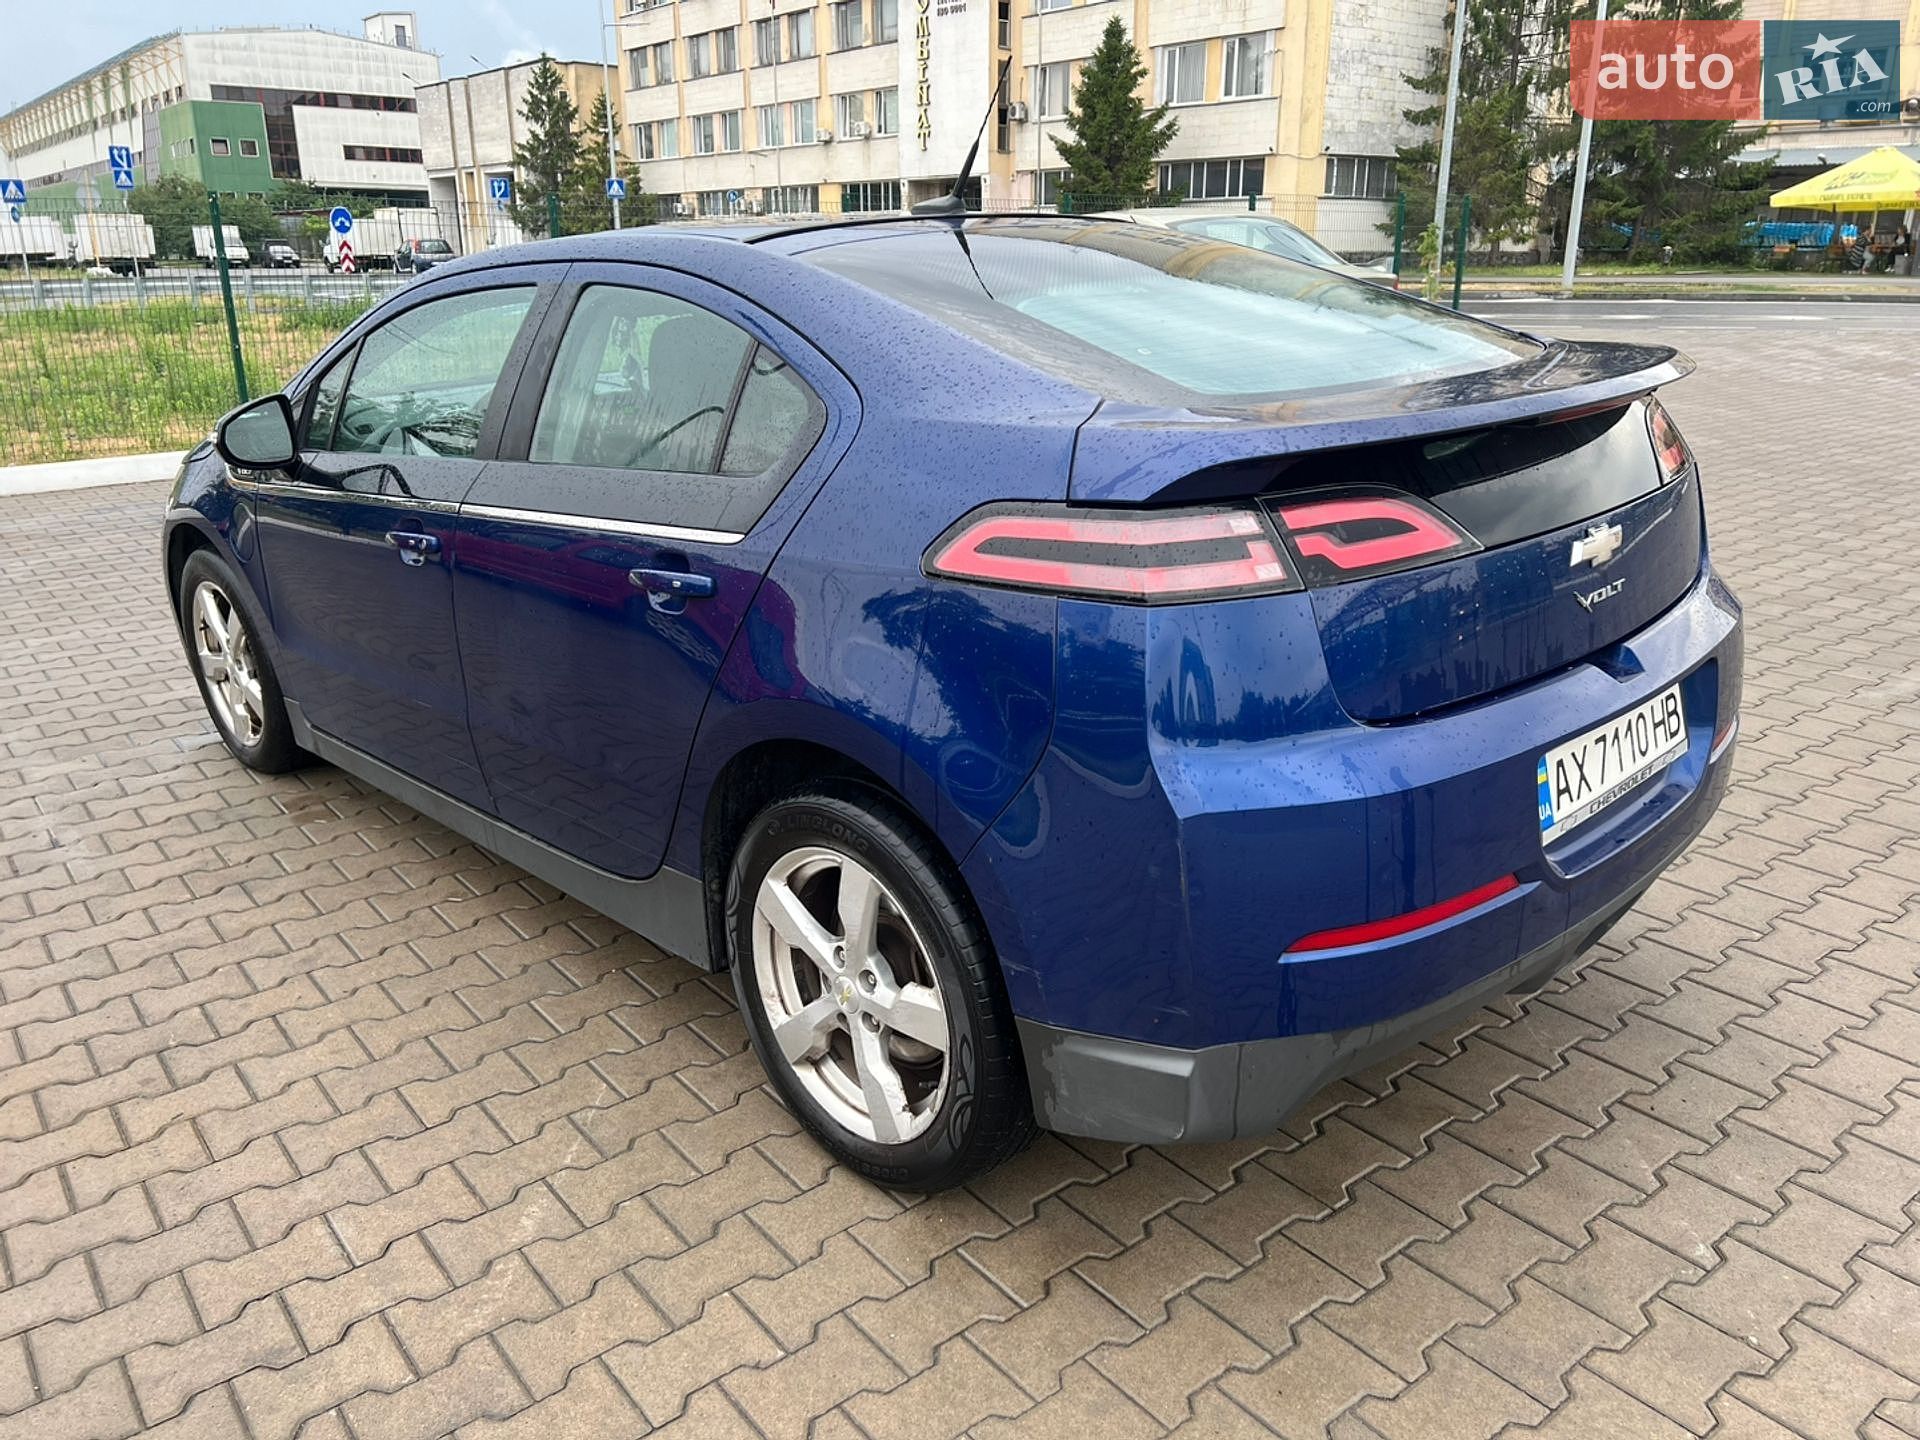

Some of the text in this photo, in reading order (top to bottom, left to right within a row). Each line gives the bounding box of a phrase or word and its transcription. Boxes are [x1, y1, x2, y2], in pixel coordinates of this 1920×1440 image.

[1573, 578, 1627, 613] VOLT
[1556, 691, 1681, 811] AX 7110 HB
[1588, 764, 1654, 815] CHEVROLET
[1539, 801, 1552, 821] UA
[786, 814, 870, 852] LINGLONG
